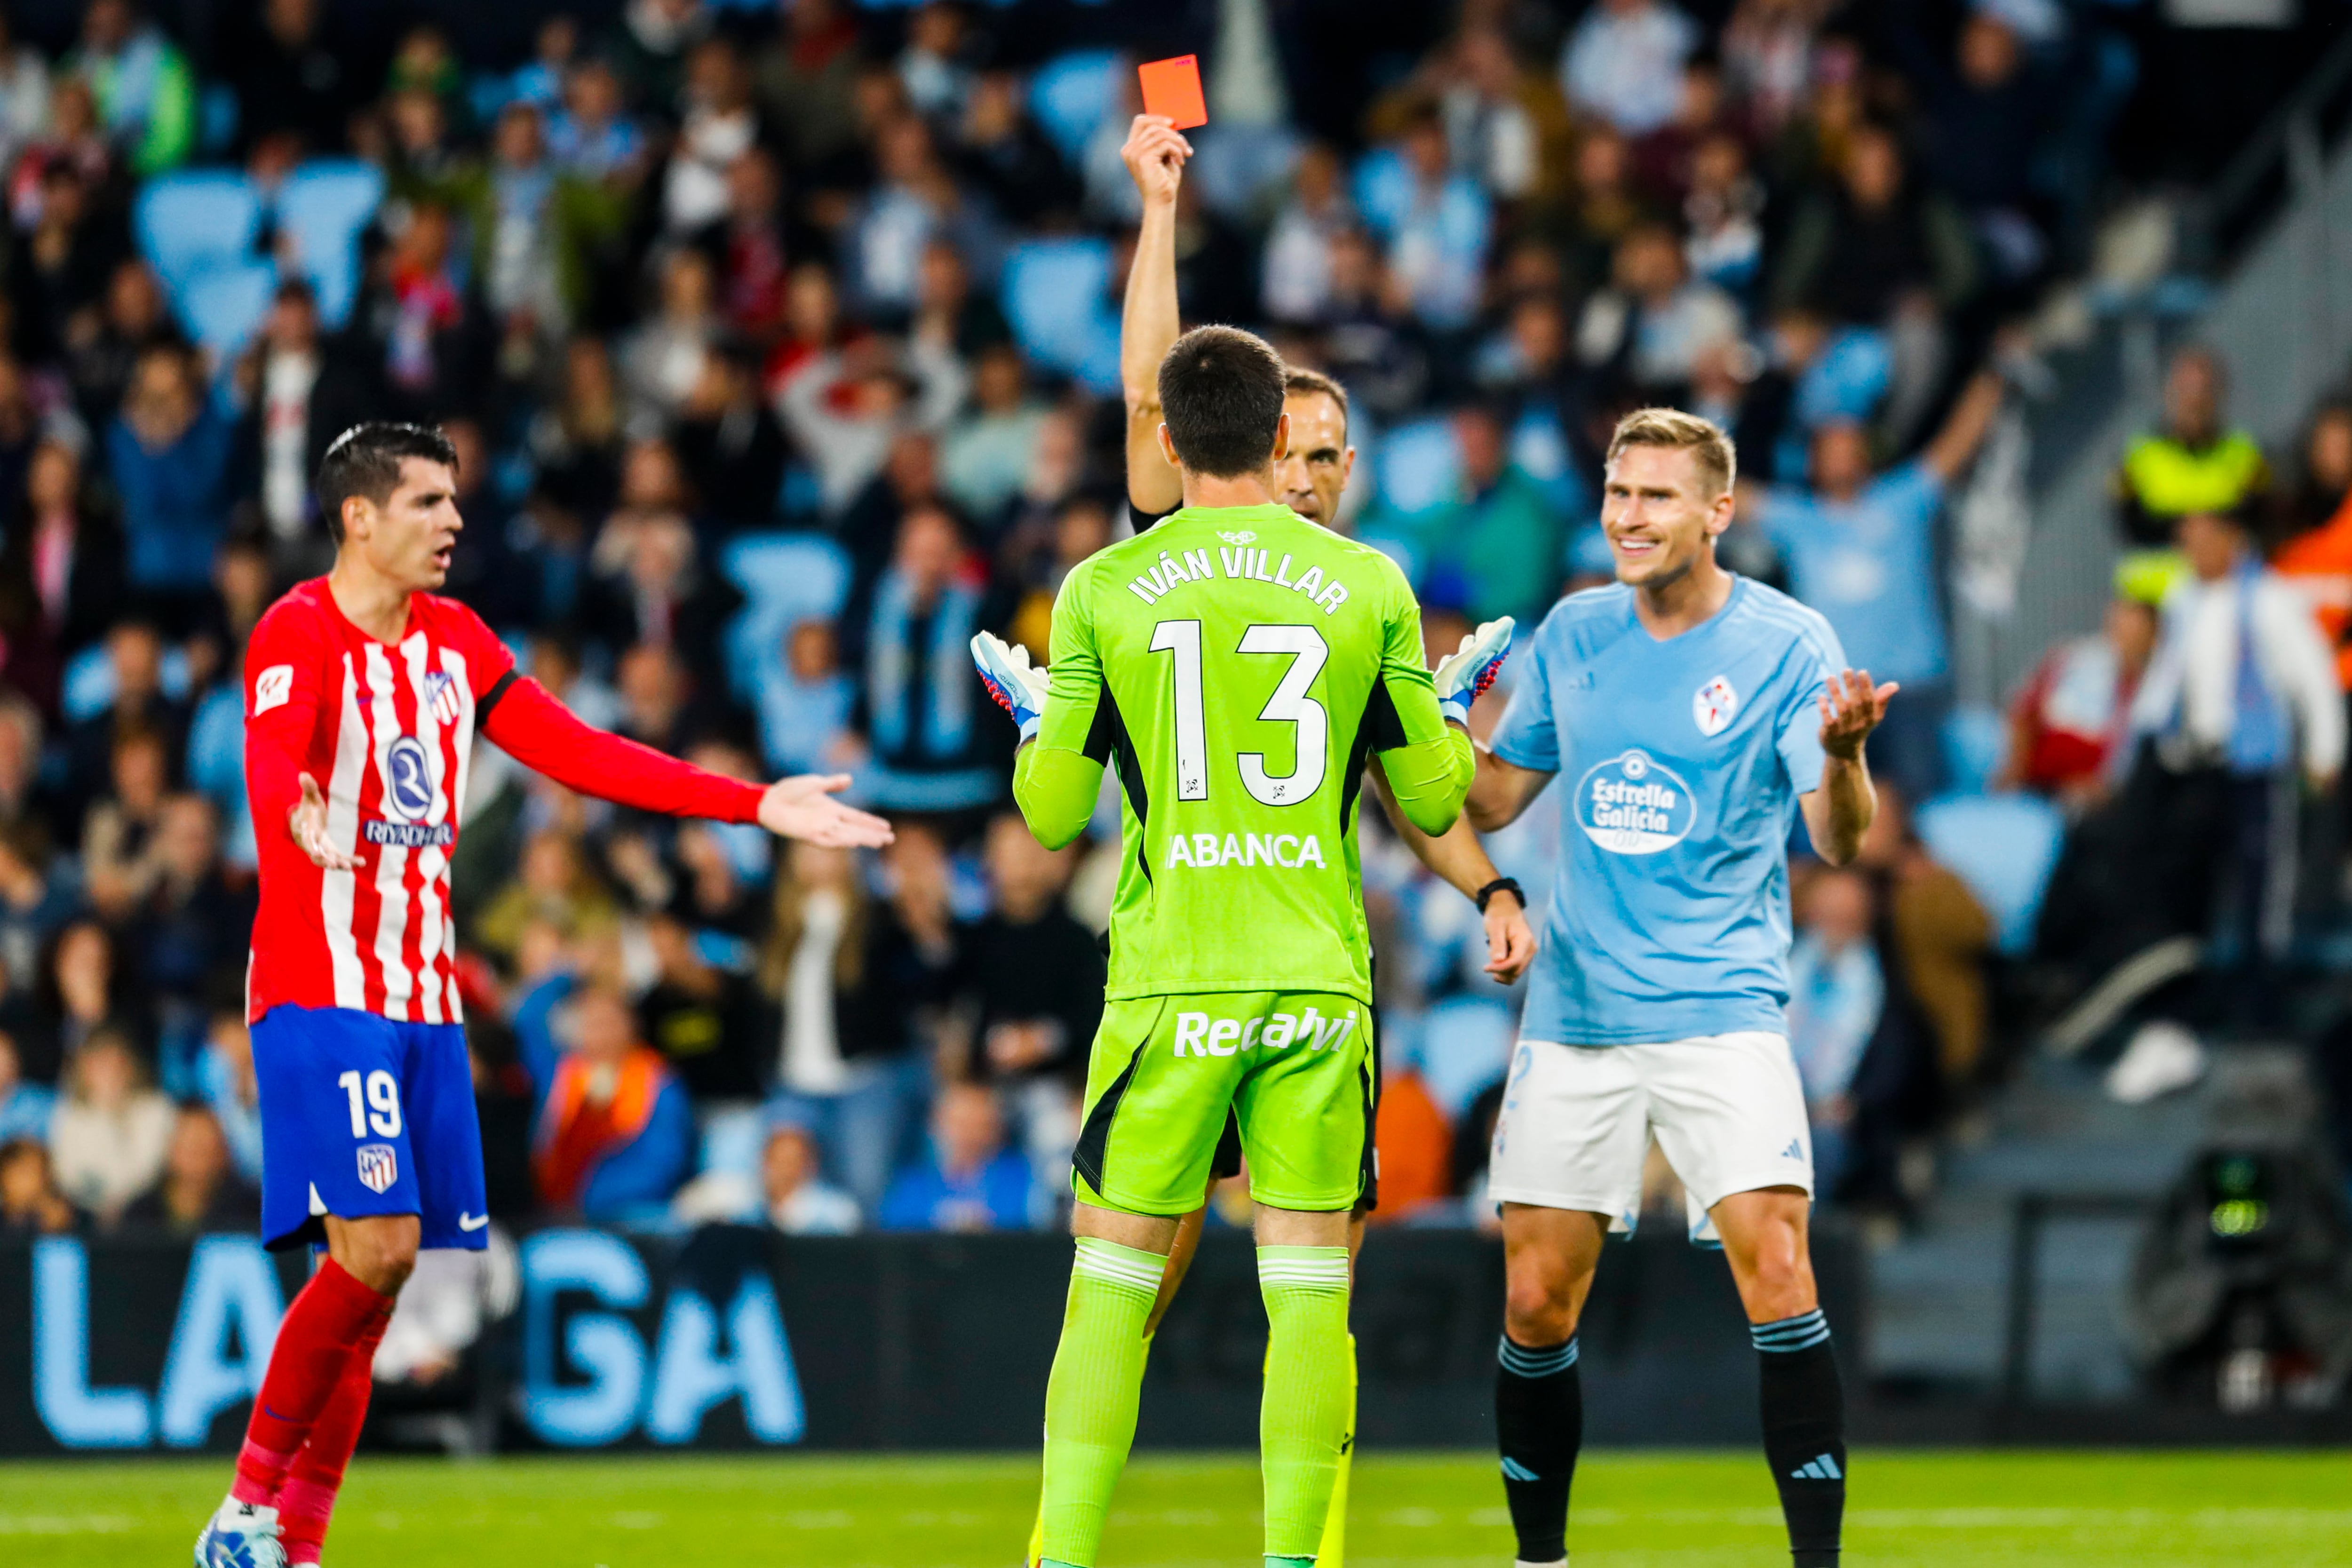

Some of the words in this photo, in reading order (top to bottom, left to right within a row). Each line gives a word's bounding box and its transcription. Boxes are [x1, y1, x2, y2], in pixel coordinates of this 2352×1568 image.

[1127, 547, 1215, 606] IVÁN
[1218, 547, 1350, 616] VILLAR
[1148, 620, 1329, 806] 13
[1592, 778, 1676, 809] Estrella
[1593, 801, 1669, 832] Galicia
[1165, 832, 1326, 870] ABANCA
[1173, 1006, 1358, 1059] Recalvi
[337, 1069, 402, 1139] 19
